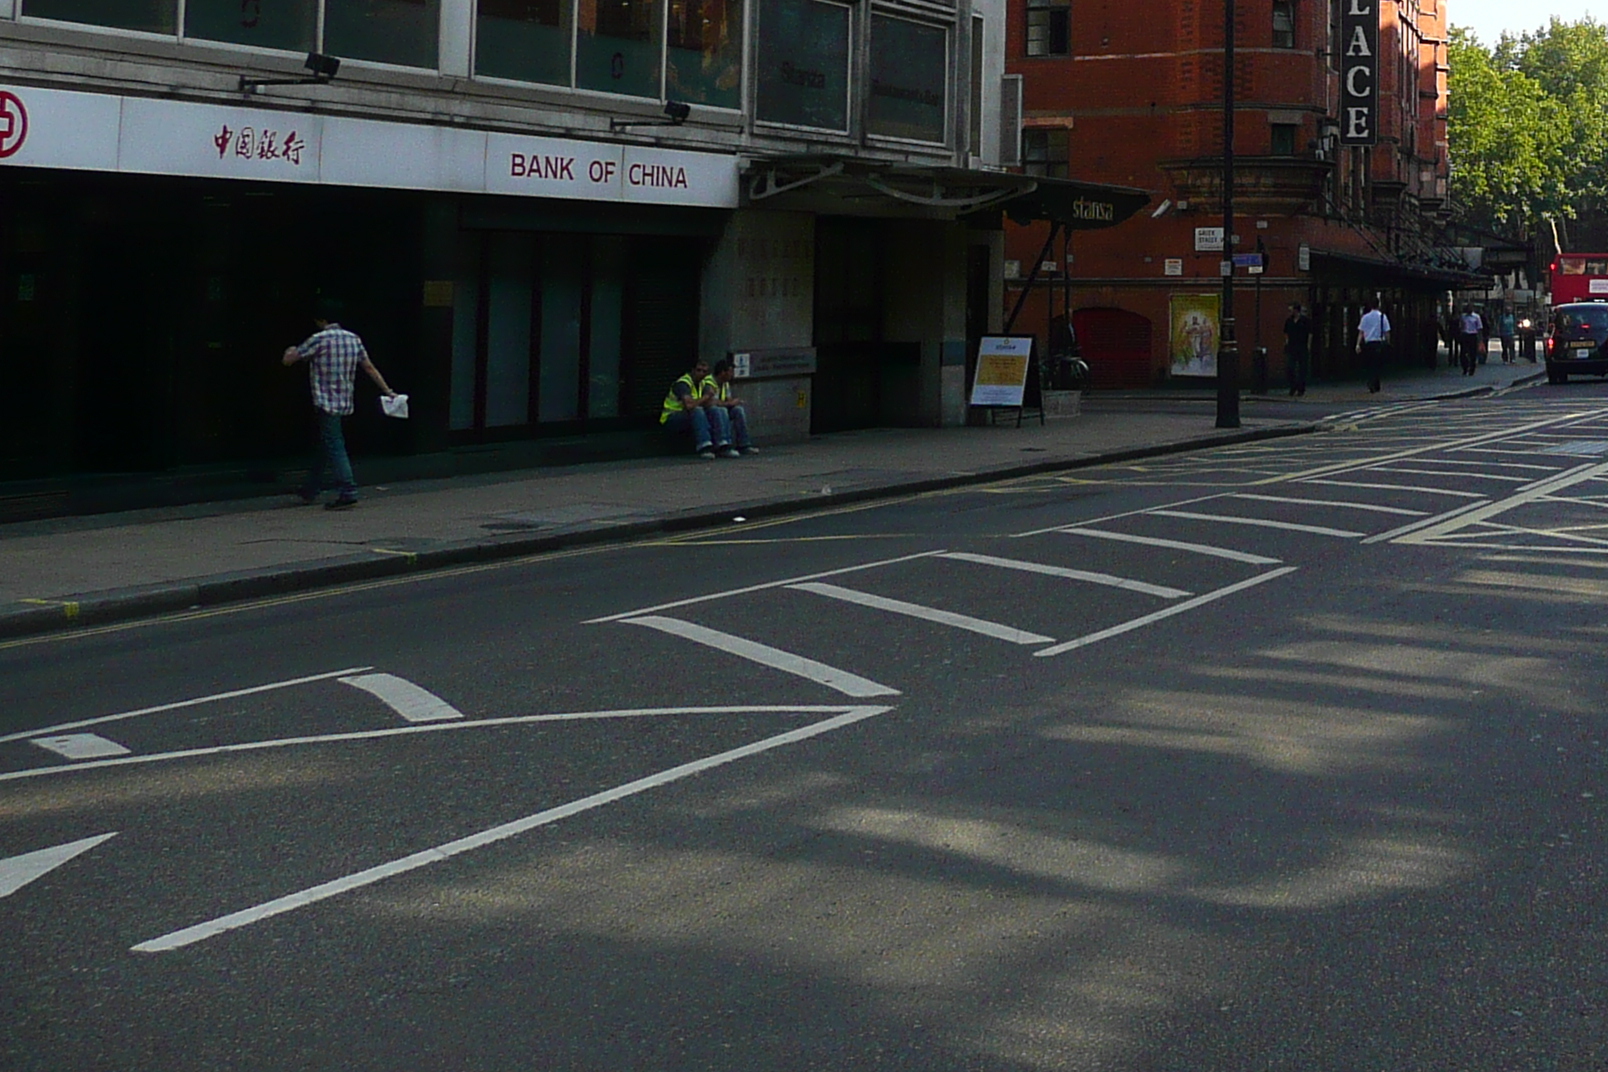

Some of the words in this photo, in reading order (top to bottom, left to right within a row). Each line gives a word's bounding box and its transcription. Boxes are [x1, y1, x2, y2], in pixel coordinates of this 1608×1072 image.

[511, 153, 574, 181] BANK
[589, 160, 616, 183] OF
[629, 163, 688, 189] CHINA
